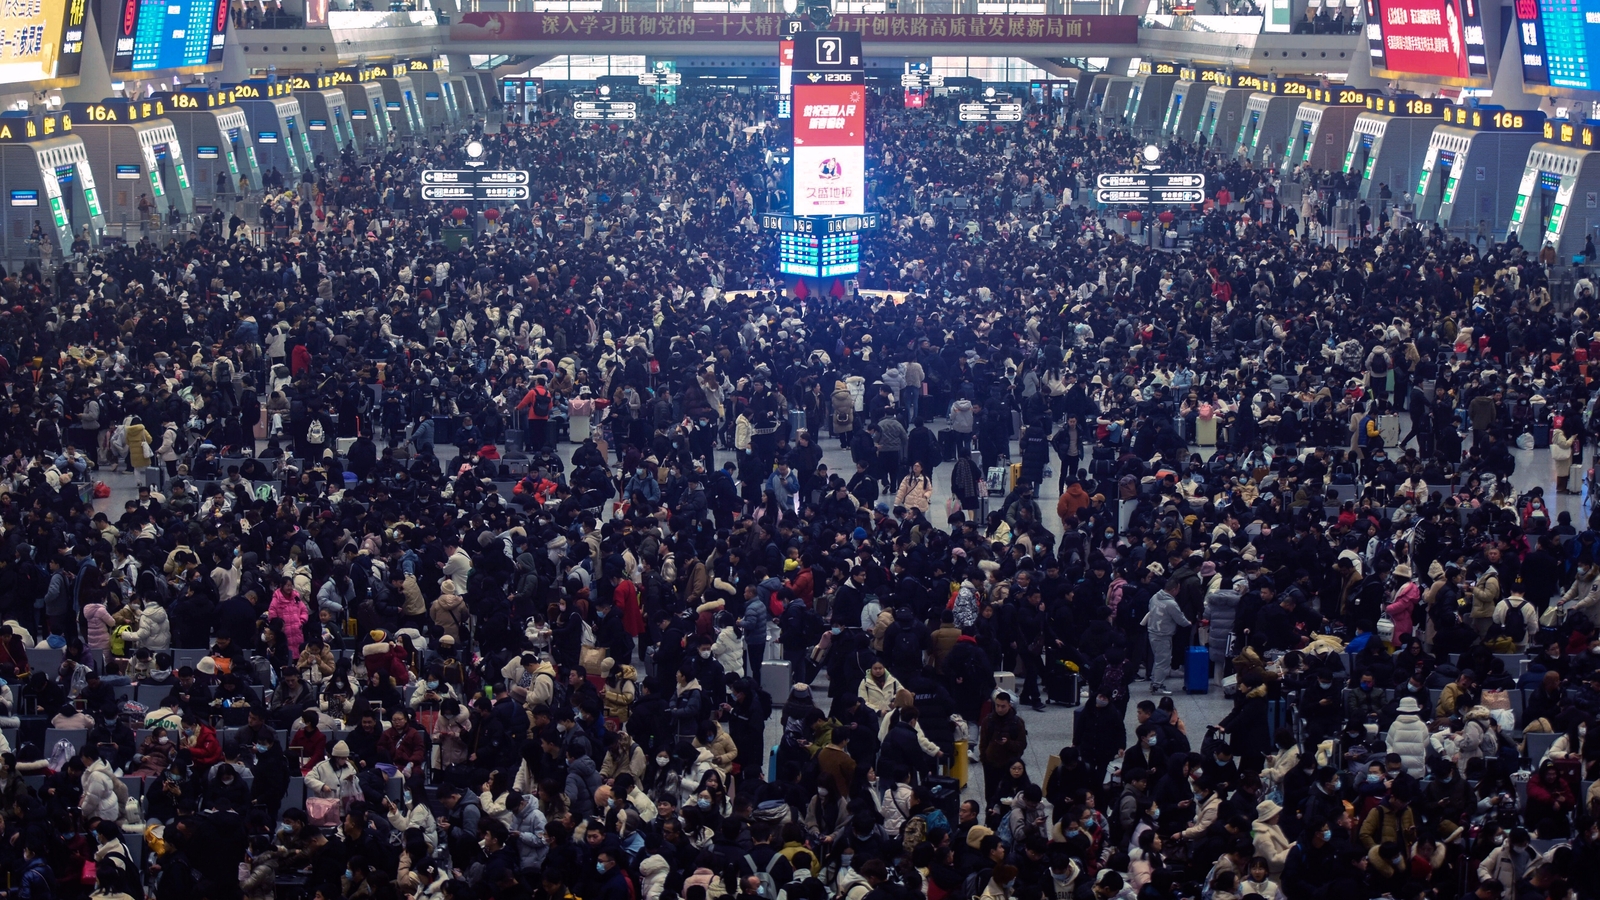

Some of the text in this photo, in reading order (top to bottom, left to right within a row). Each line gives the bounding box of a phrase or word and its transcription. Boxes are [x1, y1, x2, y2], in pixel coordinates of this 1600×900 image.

[826, 15, 1092, 38] 力开创铁路高质量发展新局面!
[410, 61, 428, 71] 28A
[849, 56, 859, 66] 西
[1156, 64, 1174, 74] 28B
[825, 74, 852, 82] 12306
[234, 85, 260, 98] 20A
[1284, 82, 1306, 94] 22B
[170, 93, 199, 108] 18A
[1339, 90, 1364, 104] 20B
[86, 105, 117, 121] 16A
[1405, 101, 1433, 115] 18B
[1492, 112, 1523, 129] 16B
[806, 186, 852, 199] 久盛地板
